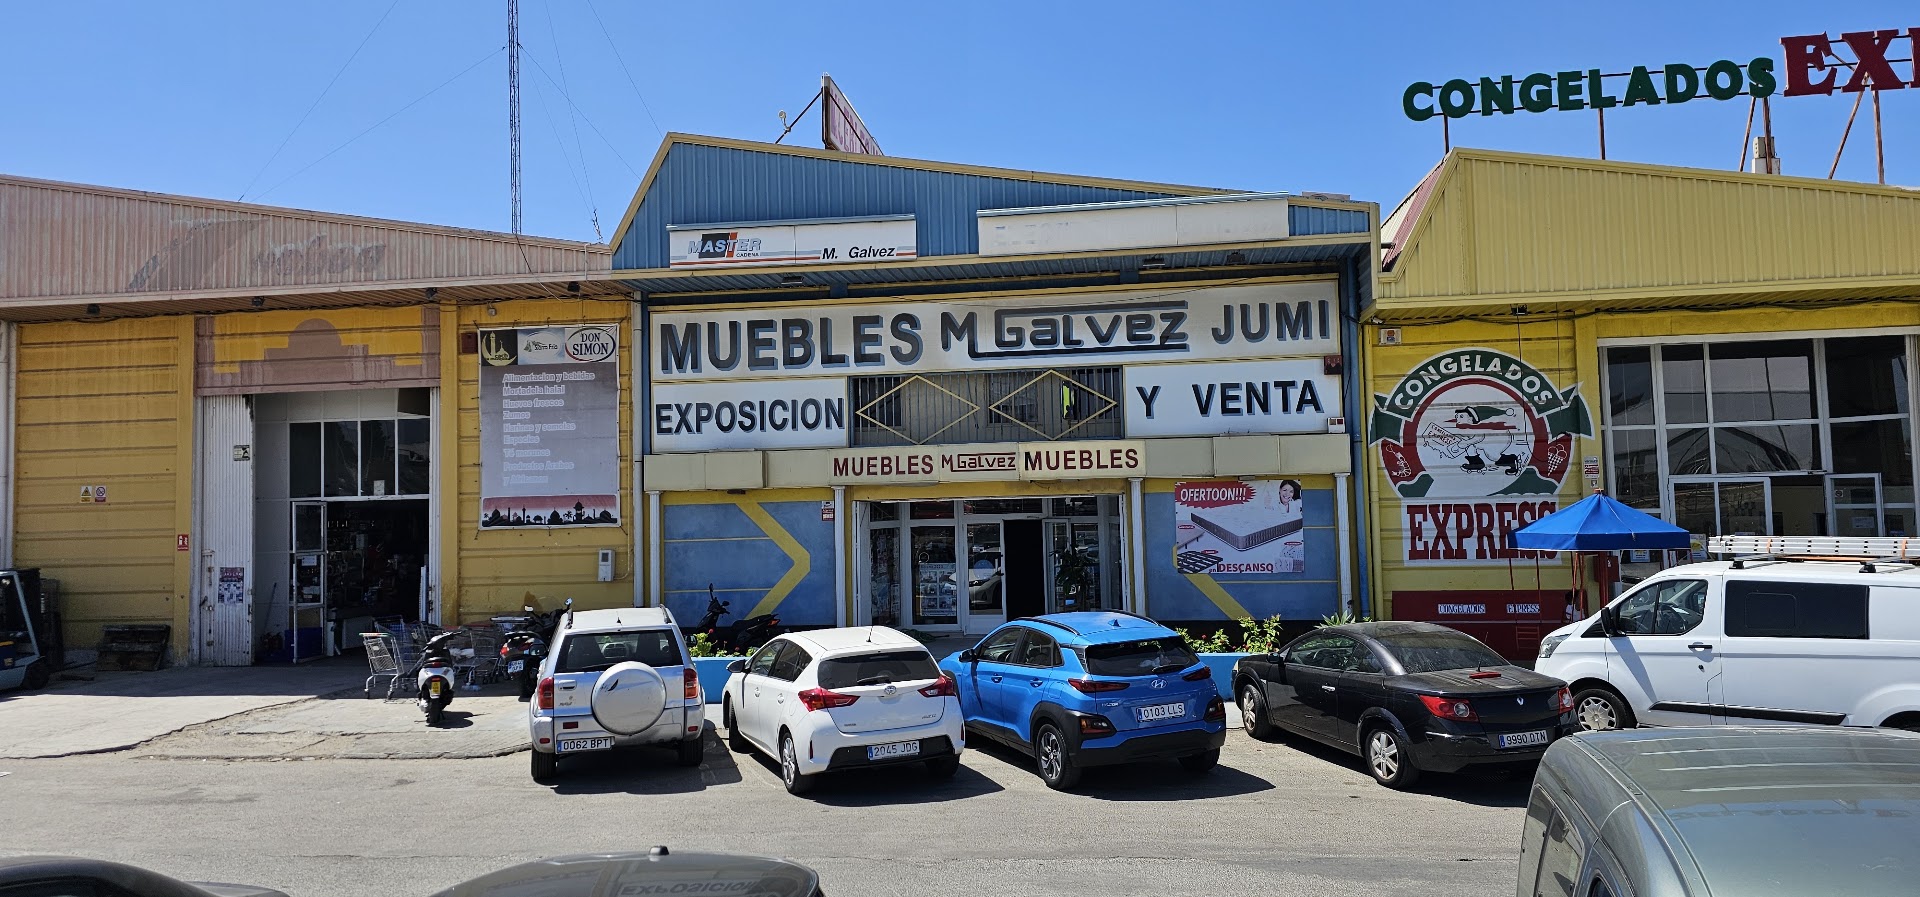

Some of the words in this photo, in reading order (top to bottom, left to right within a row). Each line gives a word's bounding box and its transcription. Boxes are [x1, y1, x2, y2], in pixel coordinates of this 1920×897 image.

[1402, 57, 1777, 121] CONGELADOS
[687, 237, 761, 254] MASTER
[822, 248, 838, 260] M.
[849, 246, 895, 259] Galvez
[581, 332, 600, 343] DON
[660, 313, 923, 374] MUEBLES
[1211, 300, 1331, 344] JUMI
[573, 342, 609, 356] SIMON
[502, 372, 555, 383] Alimentacion
[556, 373, 563, 382] y
[563, 371, 595, 381] bebidas
[1395, 354, 1553, 410] CONGELADOS
[503, 386, 543, 396] Mortadela
[544, 385, 565, 395] halal
[503, 399, 533, 408] Huevos
[533, 398, 564, 408] frescos
[1136, 386, 1161, 419] Y
[1192, 380, 1324, 417] VENTA
[503, 411, 530, 420] Zumos
[656, 398, 844, 435] EXPOSICION
[503, 423, 534, 432] Harinas
[535, 424, 541, 433] y
[503, 435, 540, 445] Especies
[503, 461, 544, 471] Productos
[834, 454, 934, 477] MUEBLES
[1024, 448, 1139, 471] MUEBLES
[1180, 487, 1246, 502] OFERTOON!!!
[1144, 706, 1166, 718] 0103
[1168, 704, 1184, 715] LLS
[563, 741, 588, 750] 0062
[590, 739, 608, 748] BPT
[1506, 734, 1528, 745] 9990
[1529, 732, 1546, 742] DTN
[874, 745, 897, 756] 2045
[901, 742, 918, 753] JDG
